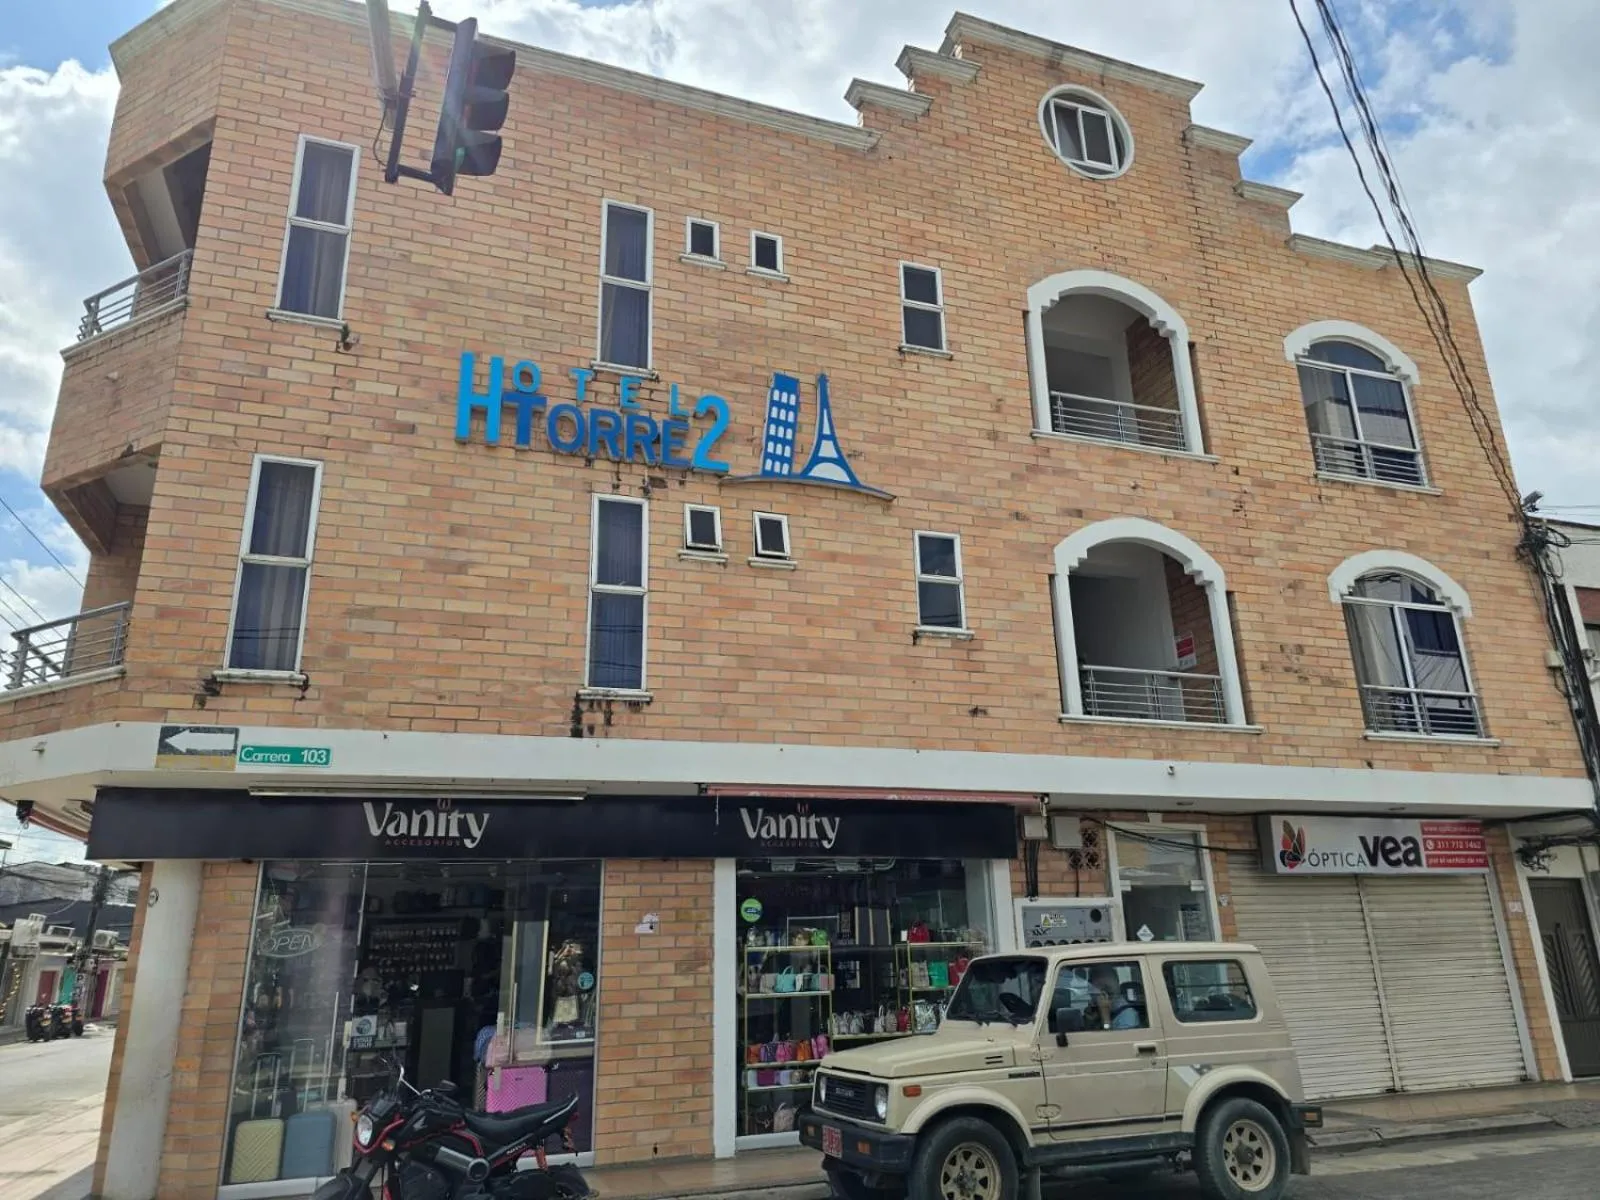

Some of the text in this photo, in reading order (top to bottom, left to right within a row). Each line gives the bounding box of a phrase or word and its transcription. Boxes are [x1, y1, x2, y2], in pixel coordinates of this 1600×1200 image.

[502, 391, 732, 474] TORRE 2
[240, 747, 327, 764] Carrera 103
[362, 801, 491, 849] Vanity
[739, 807, 841, 849] Vanity
[1308, 834, 1424, 868] ÓPTICA vea
[262, 934, 312, 953] OPEN
